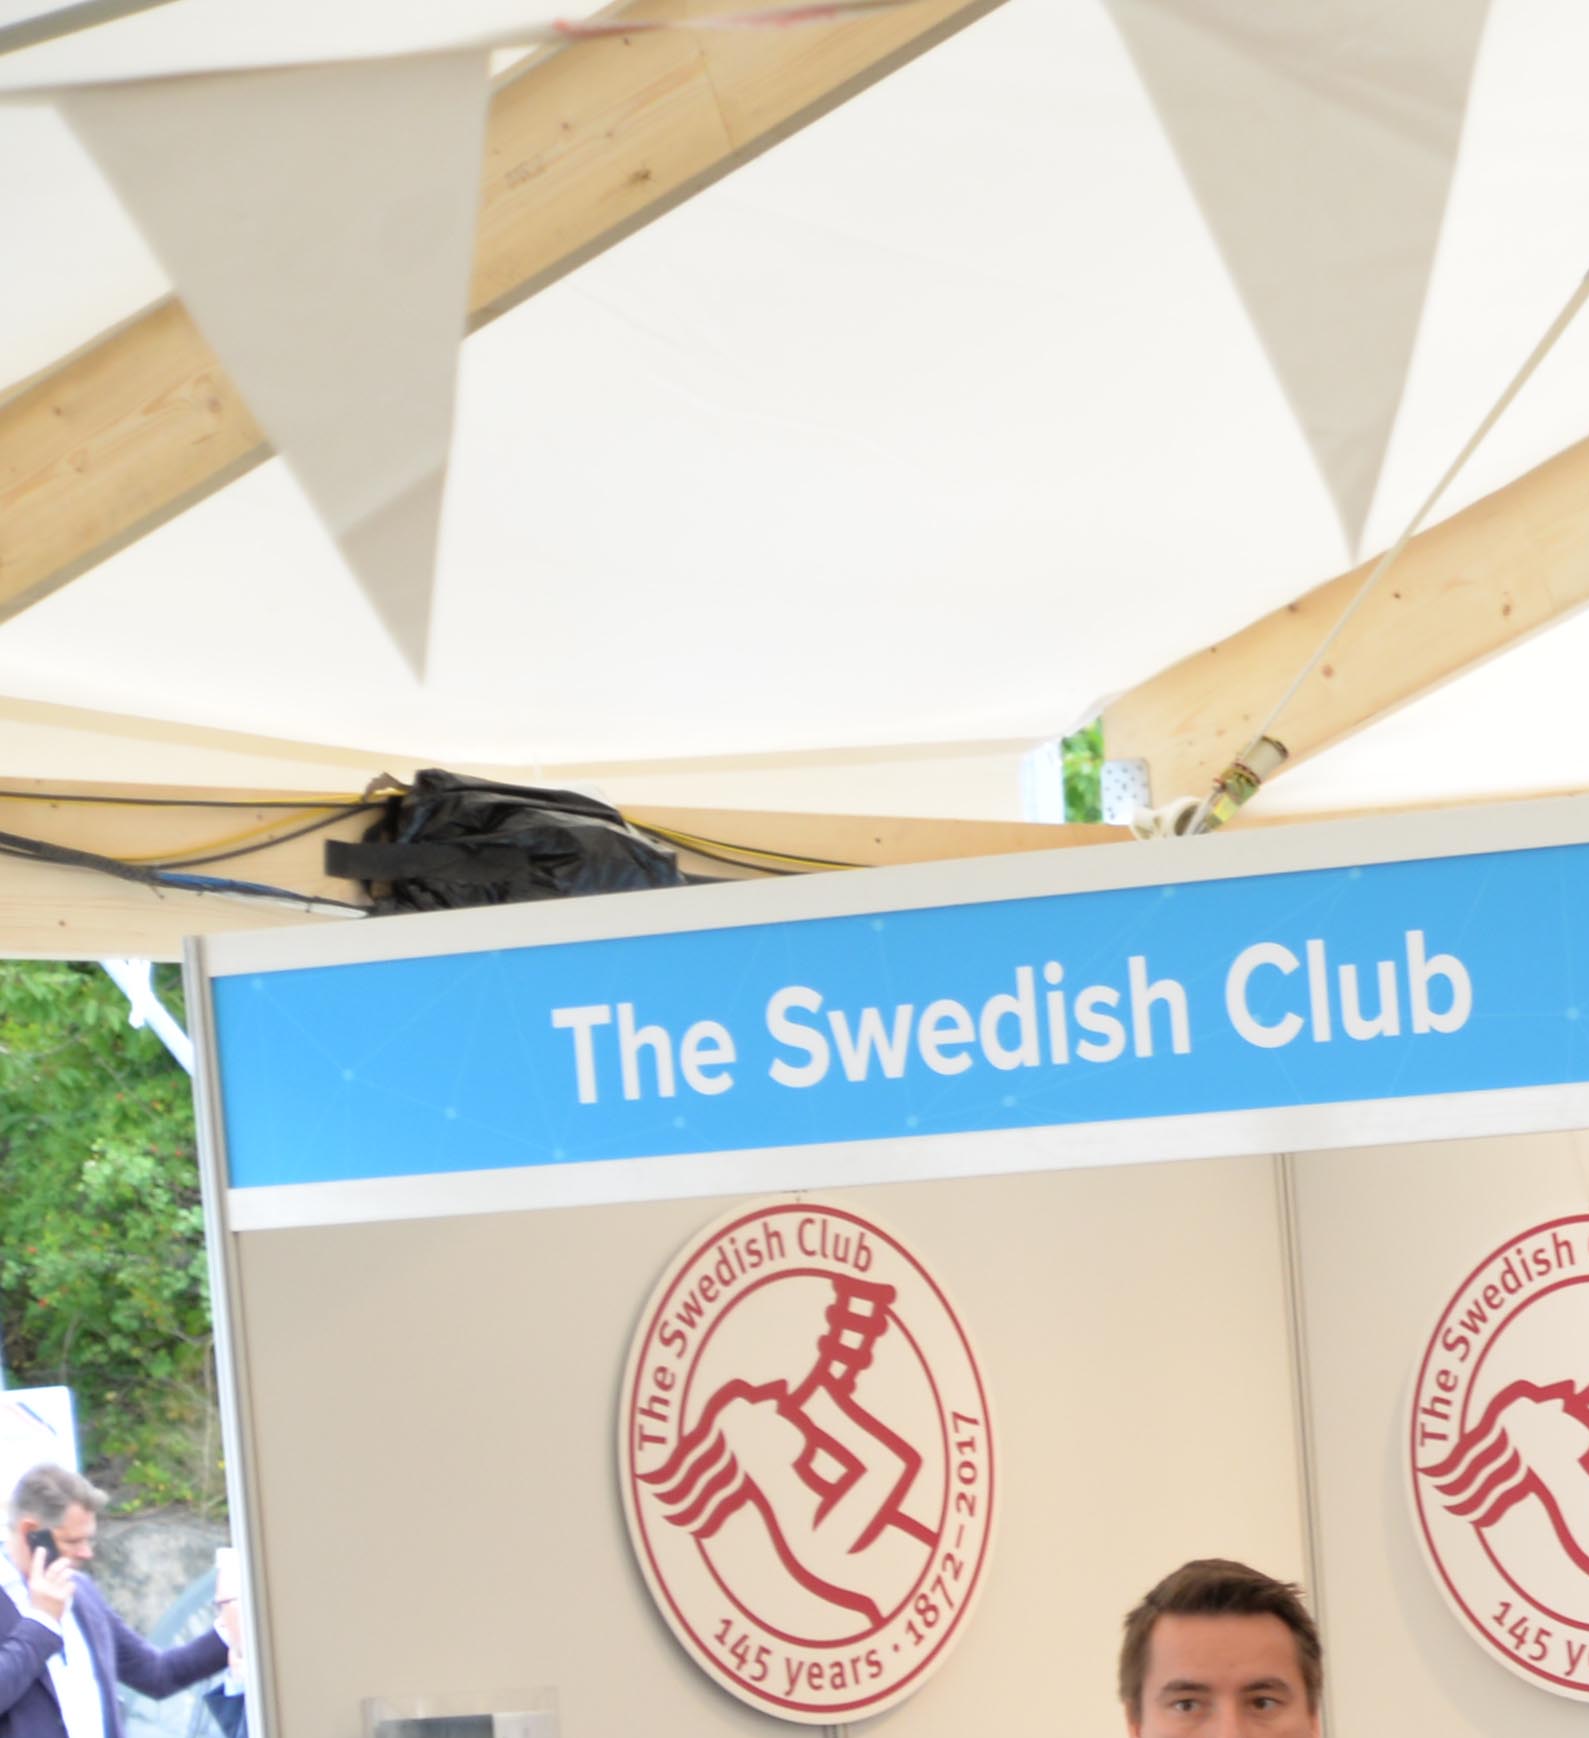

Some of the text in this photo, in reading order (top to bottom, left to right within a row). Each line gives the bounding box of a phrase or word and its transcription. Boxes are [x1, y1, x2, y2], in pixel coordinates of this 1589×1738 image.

[551, 930, 1473, 1104] The Swedish Club
[636, 1217, 875, 1452] The Swedish Club
[1418, 1368, 1459, 1447] The
[1441, 1231, 1576, 1363] Swedish
[713, 1618, 771, 1683] 145
[784, 1647, 884, 1697] years
[1491, 1601, 1553, 1664] 145
